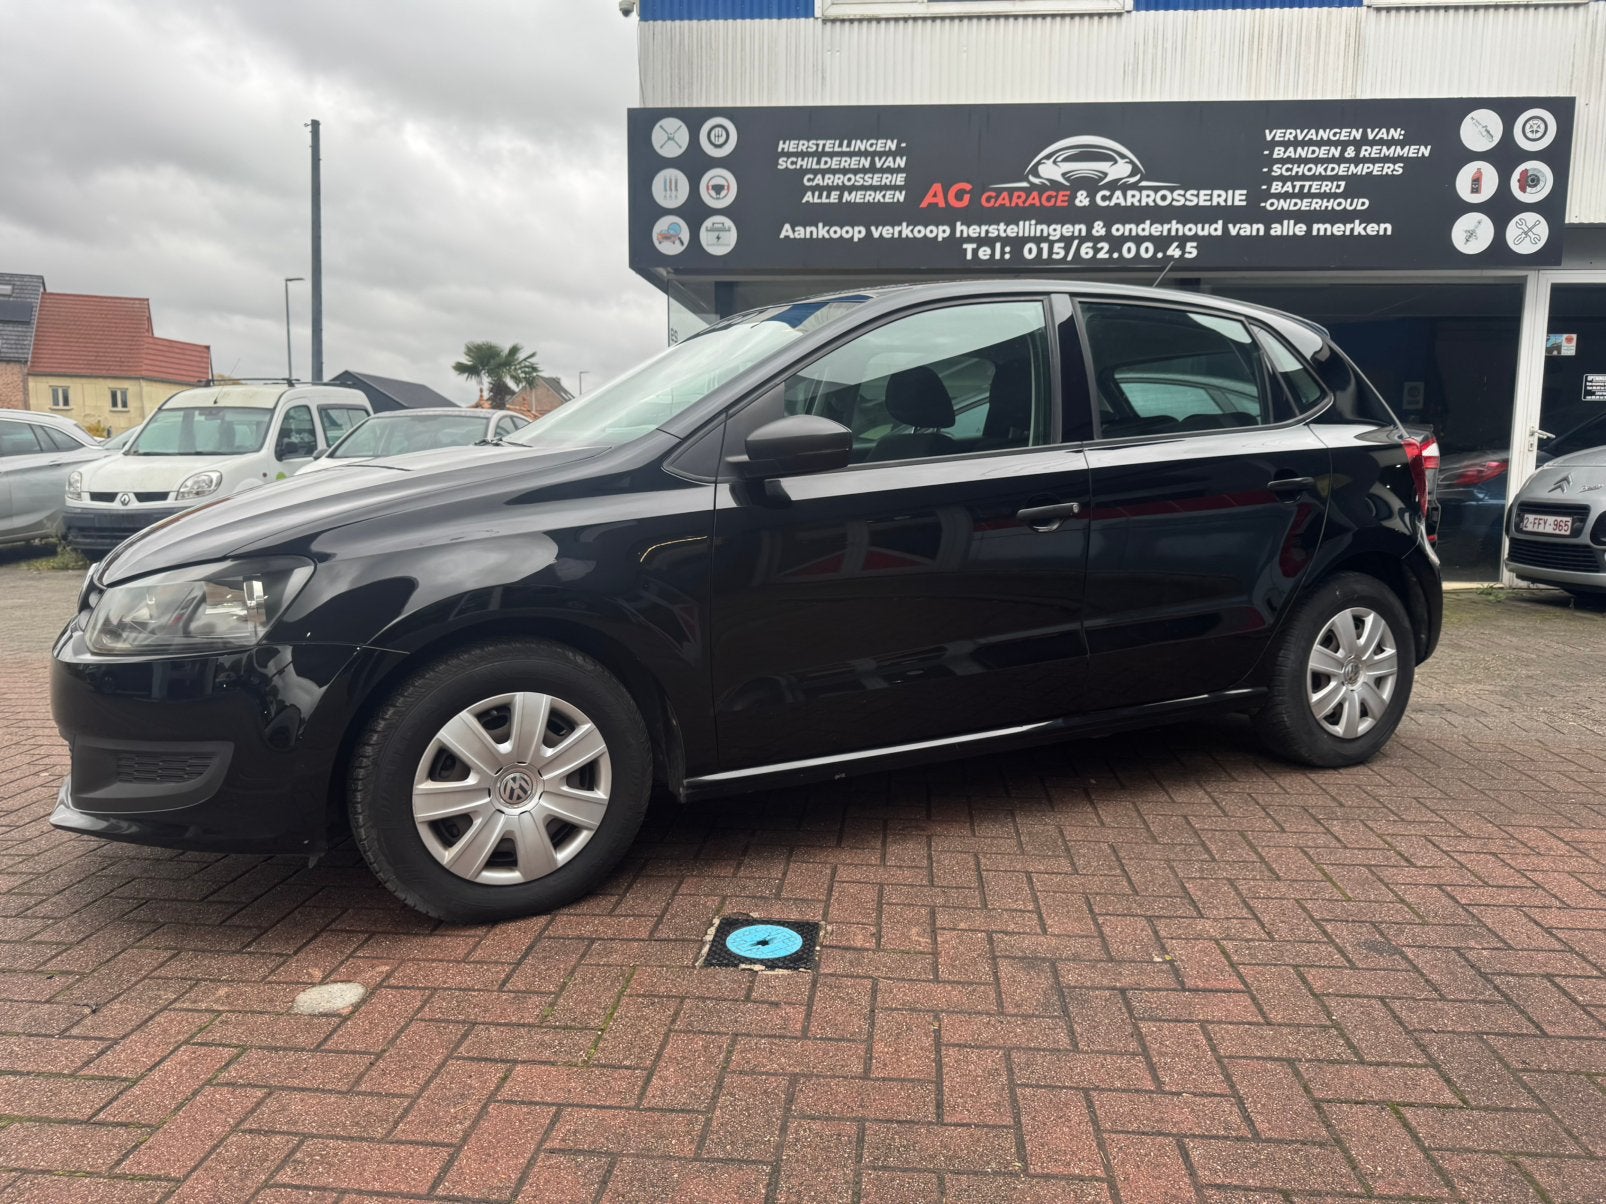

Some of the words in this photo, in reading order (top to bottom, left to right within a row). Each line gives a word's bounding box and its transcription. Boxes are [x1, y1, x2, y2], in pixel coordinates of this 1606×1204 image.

[1265, 128, 1363, 141] VERVANGEN
[1367, 128, 1405, 140] VAN:
[778, 139, 897, 152] HERSTELLINGEN
[1273, 146, 1341, 158] BANDEN
[1344, 146, 1356, 158] &
[1360, 145, 1431, 157] REMMEN
[778, 157, 871, 169] SCHILDEREN
[875, 156, 906, 168] VAN
[1271, 163, 1404, 176] SCHOKDEMPERS
[803, 173, 906, 186] CARROSSERIE
[1270, 181, 1346, 193] BATTERIJ
[802, 191, 840, 203] ALLE
[842, 190, 905, 202] MERKEN
[920, 182, 972, 208] AG
[981, 191, 1070, 207] GARAGE
[1075, 190, 1090, 206] &
[1096, 190, 1247, 206] CARROSSERIE
[1260, 199, 1369, 210] -ONDERHOUD
[780, 223, 866, 241] Aankoop
[871, 222, 950, 241] verkoop
[956, 220, 1086, 240] herstellingen
[1092, 221, 1106, 236] &
[1111, 220, 1223, 236] onderhoud
[1228, 224, 1264, 235] van
[1270, 220, 1307, 235] alle
[1312, 220, 1392, 235] merken
[963, 242, 1010, 260] Tel:
[1023, 240, 1197, 261] 015/62.00.45
[1524, 517, 1570, 532] 2-FFY-965
